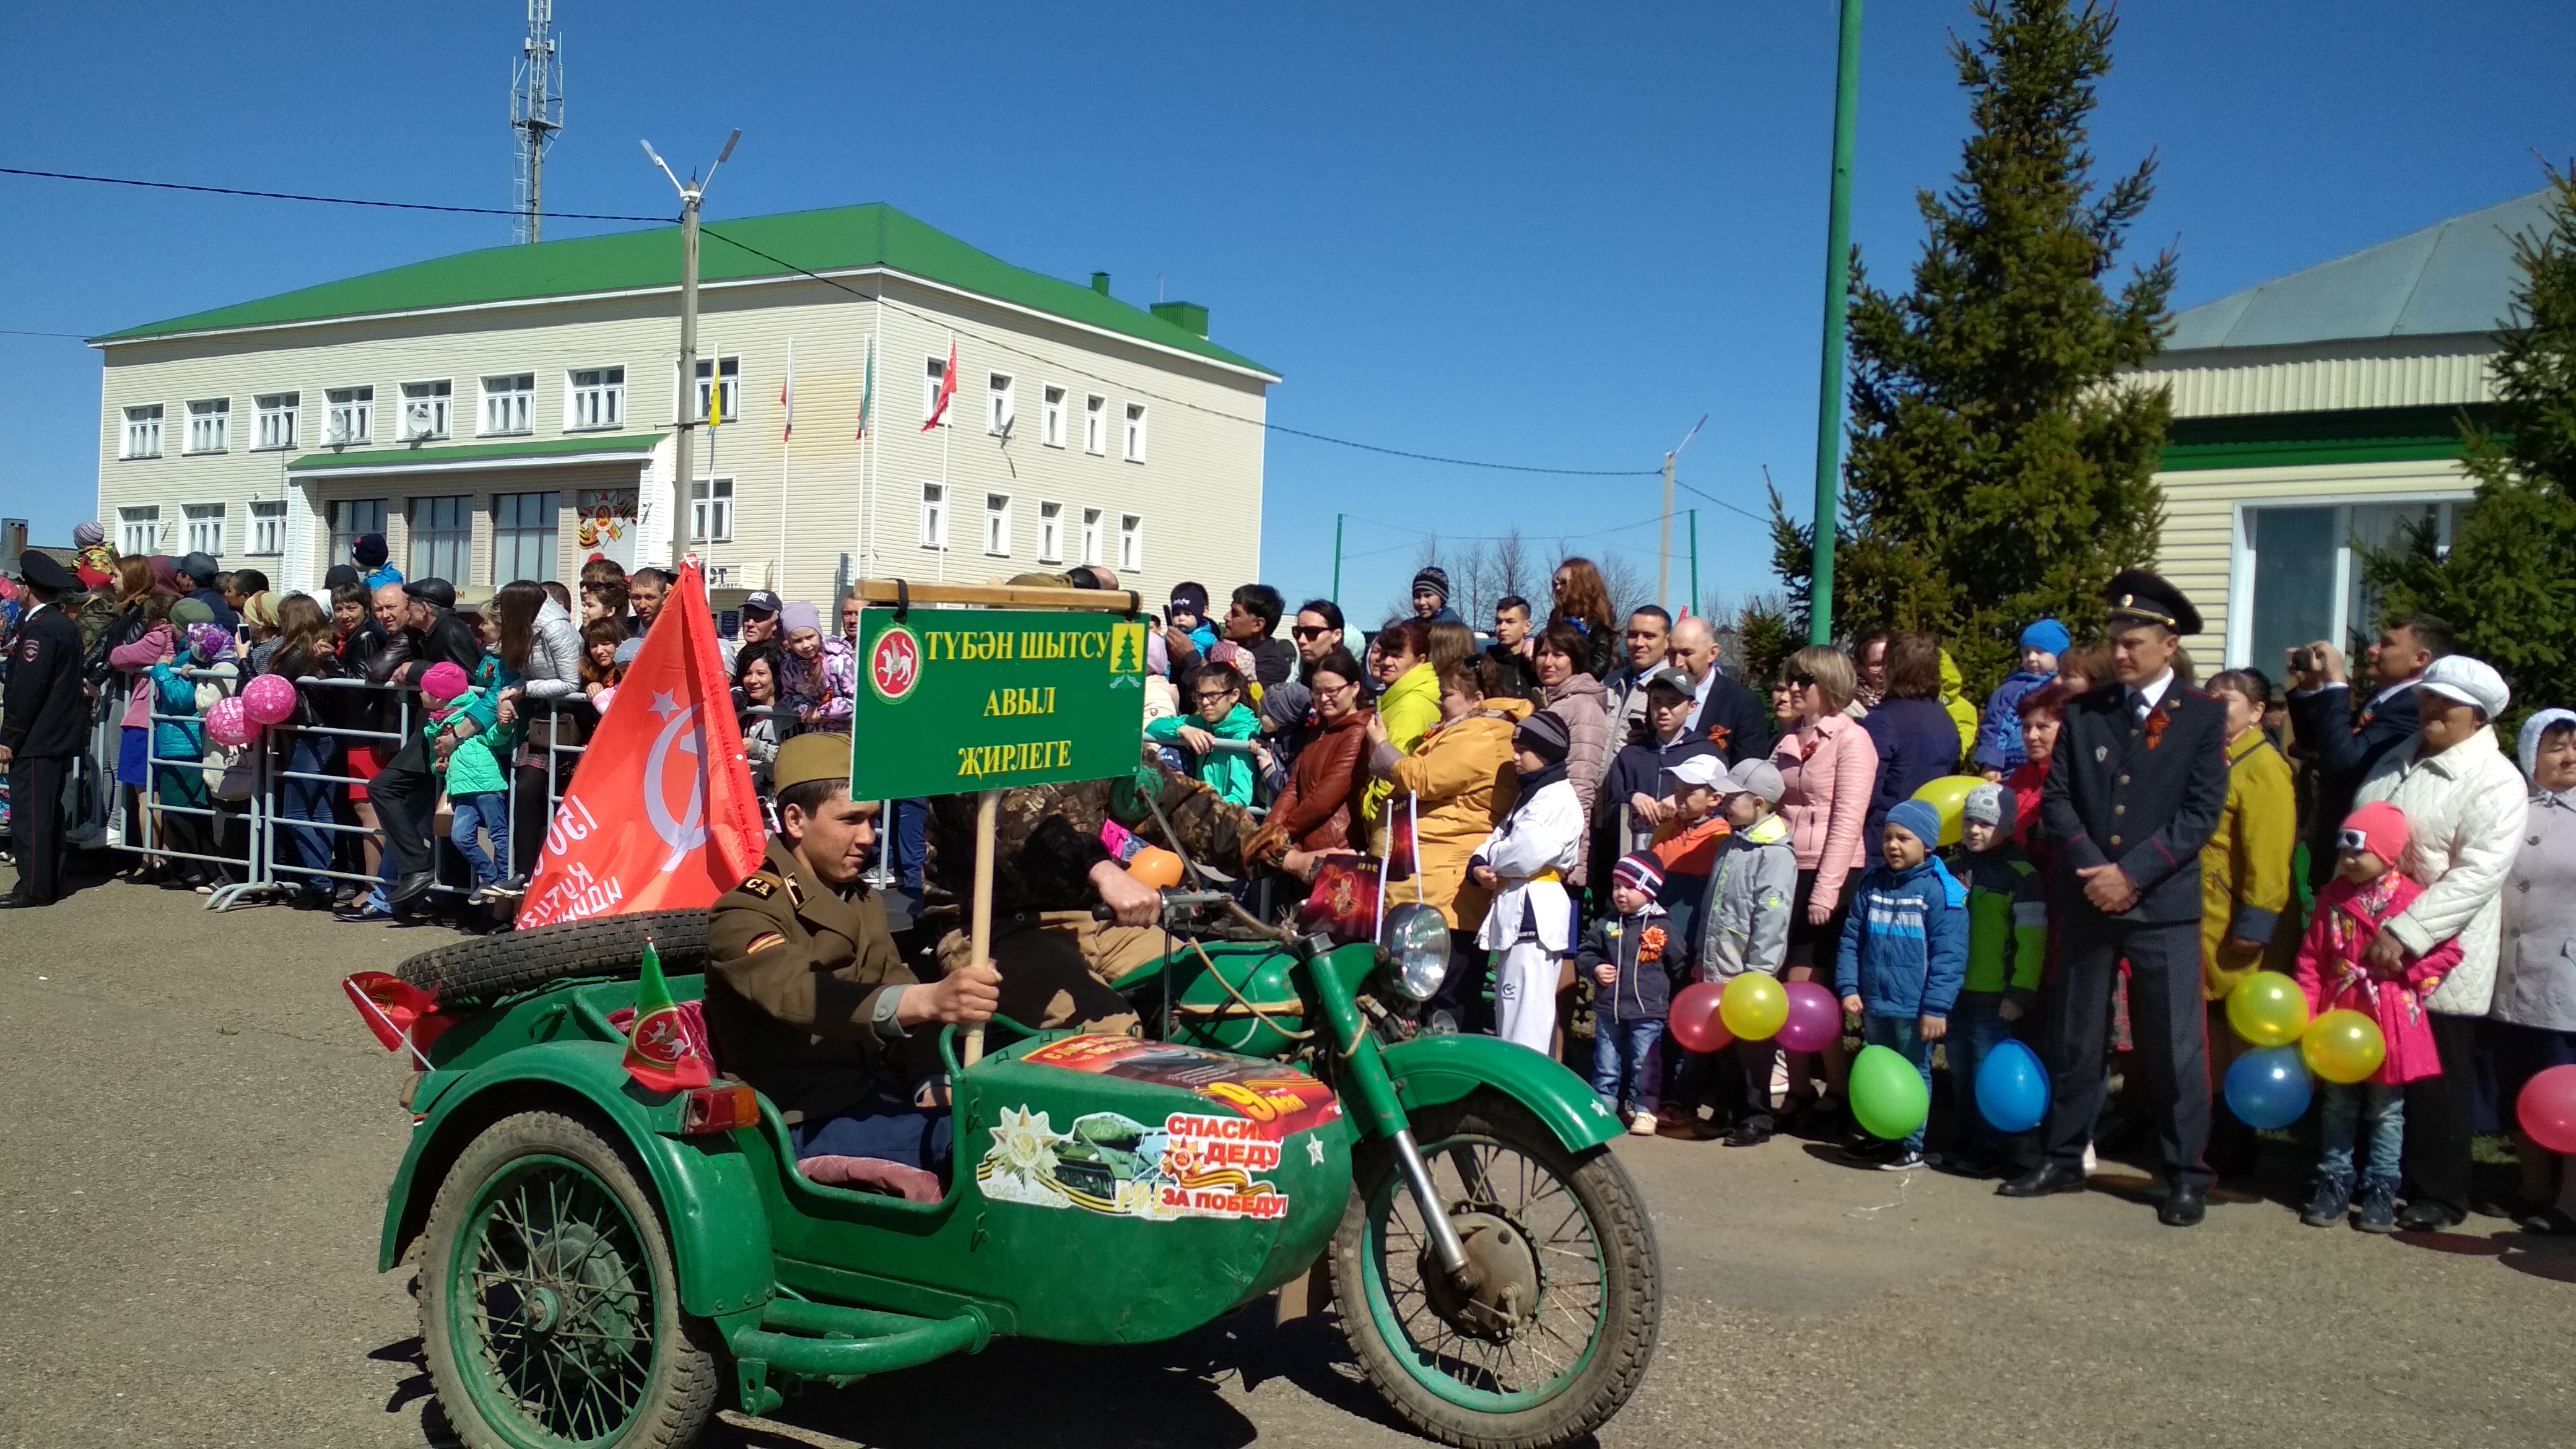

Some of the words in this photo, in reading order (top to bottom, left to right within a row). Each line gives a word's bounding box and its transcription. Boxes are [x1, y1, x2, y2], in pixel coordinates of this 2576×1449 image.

[925, 631, 1013, 660] ТҮБӘН
[1019, 631, 1111, 659] ШЫТСУ
[983, 687, 1056, 717] АВЫЛ
[957, 740, 1072, 780] ҖИРЛЕГЕ
[746, 879, 770, 896] СА
[1167, 1116, 1262, 1141] СПАСИ
[1203, 1140, 1280, 1169] ДЕДУ
[984, 1182, 1017, 1199] 1941
[1162, 1187, 1191, 1208] ЗА
[1194, 1191, 1290, 1218] ПОБЕДУ!
